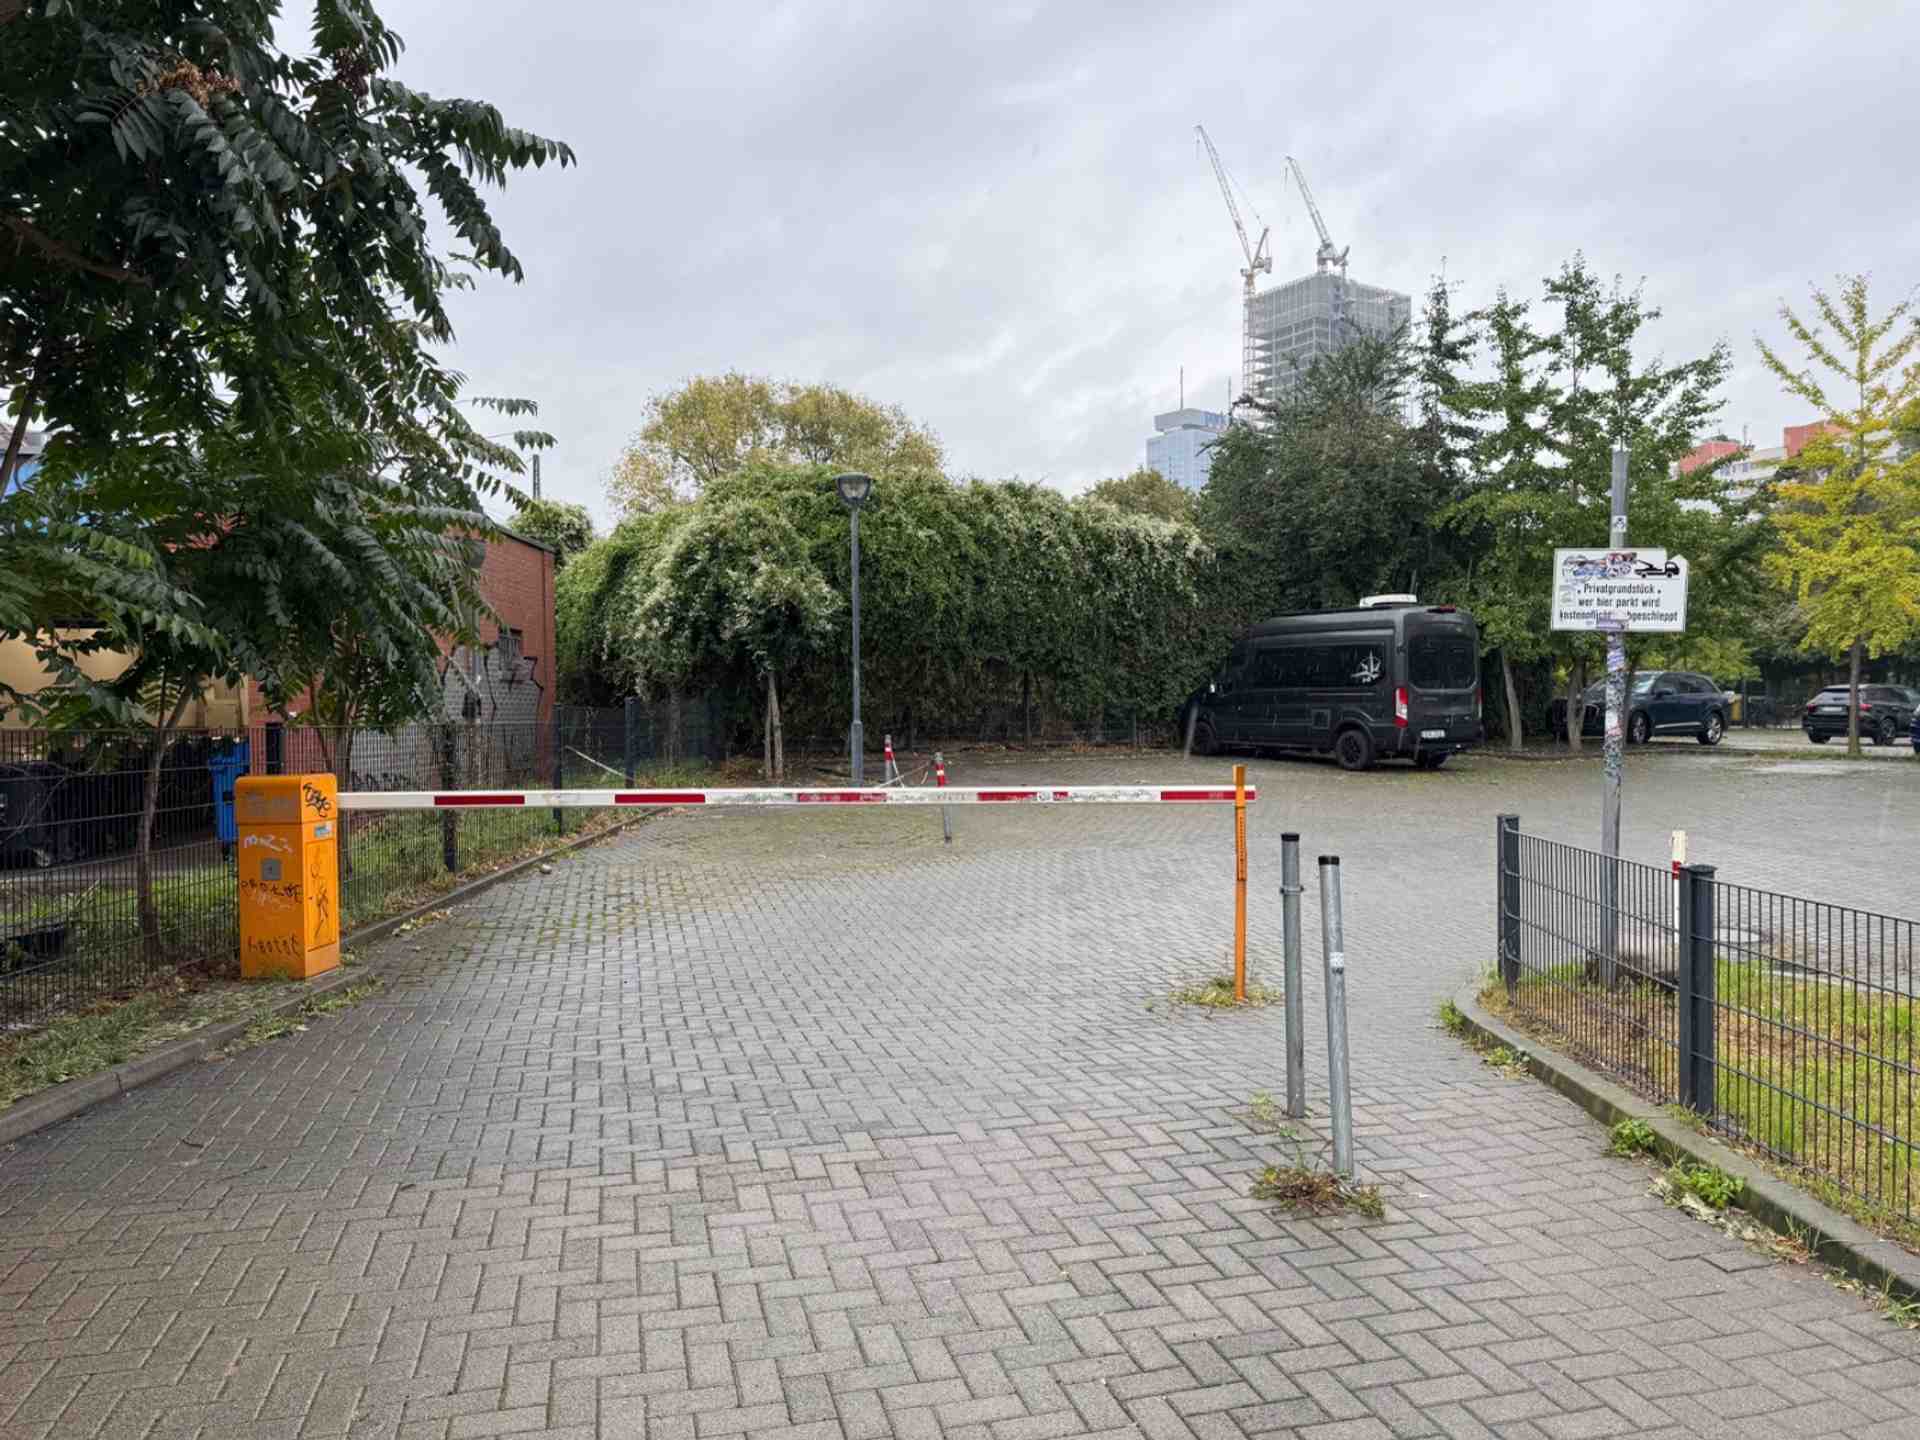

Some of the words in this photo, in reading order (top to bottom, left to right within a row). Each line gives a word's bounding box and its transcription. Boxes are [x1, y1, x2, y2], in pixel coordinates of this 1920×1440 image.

[1584, 584, 1654, 595] Privatgrundstück
[1578, 598, 1594, 606] wer
[1597, 597, 1612, 607] hier
[1616, 597, 1638, 609] parkt
[1642, 597, 1661, 607] wird
